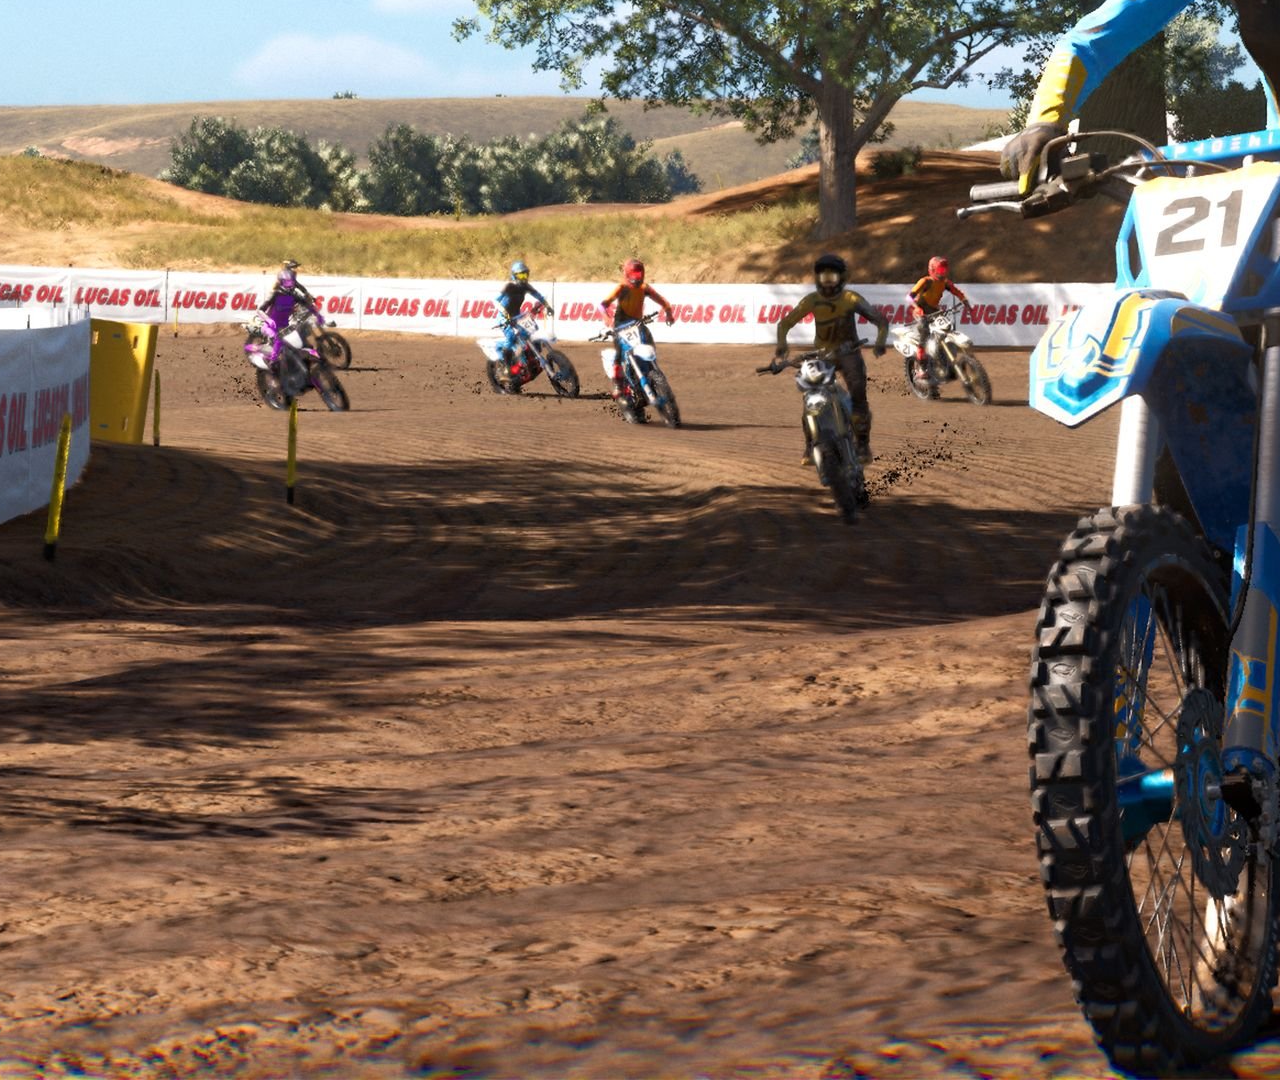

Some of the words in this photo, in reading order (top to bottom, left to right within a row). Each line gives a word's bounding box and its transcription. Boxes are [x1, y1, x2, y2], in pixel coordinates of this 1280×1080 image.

[1154, 189, 1244, 257] 21
[35, 284, 65, 304] OIL
[73, 286, 131, 307] LUCAS
[132, 288, 162, 308] OIL
[171, 290, 232, 311] LUCAS
[233, 293, 258, 311] OIL
[326, 295, 355, 315] OIL
[363, 296, 420, 317] LUCAS
[422, 298, 451, 318] OIL
[718, 304, 746, 324] OIL
[960, 304, 1019, 325] LUCAS
[1021, 304, 1049, 325] OIL
[7, 392, 27, 455] OIL
